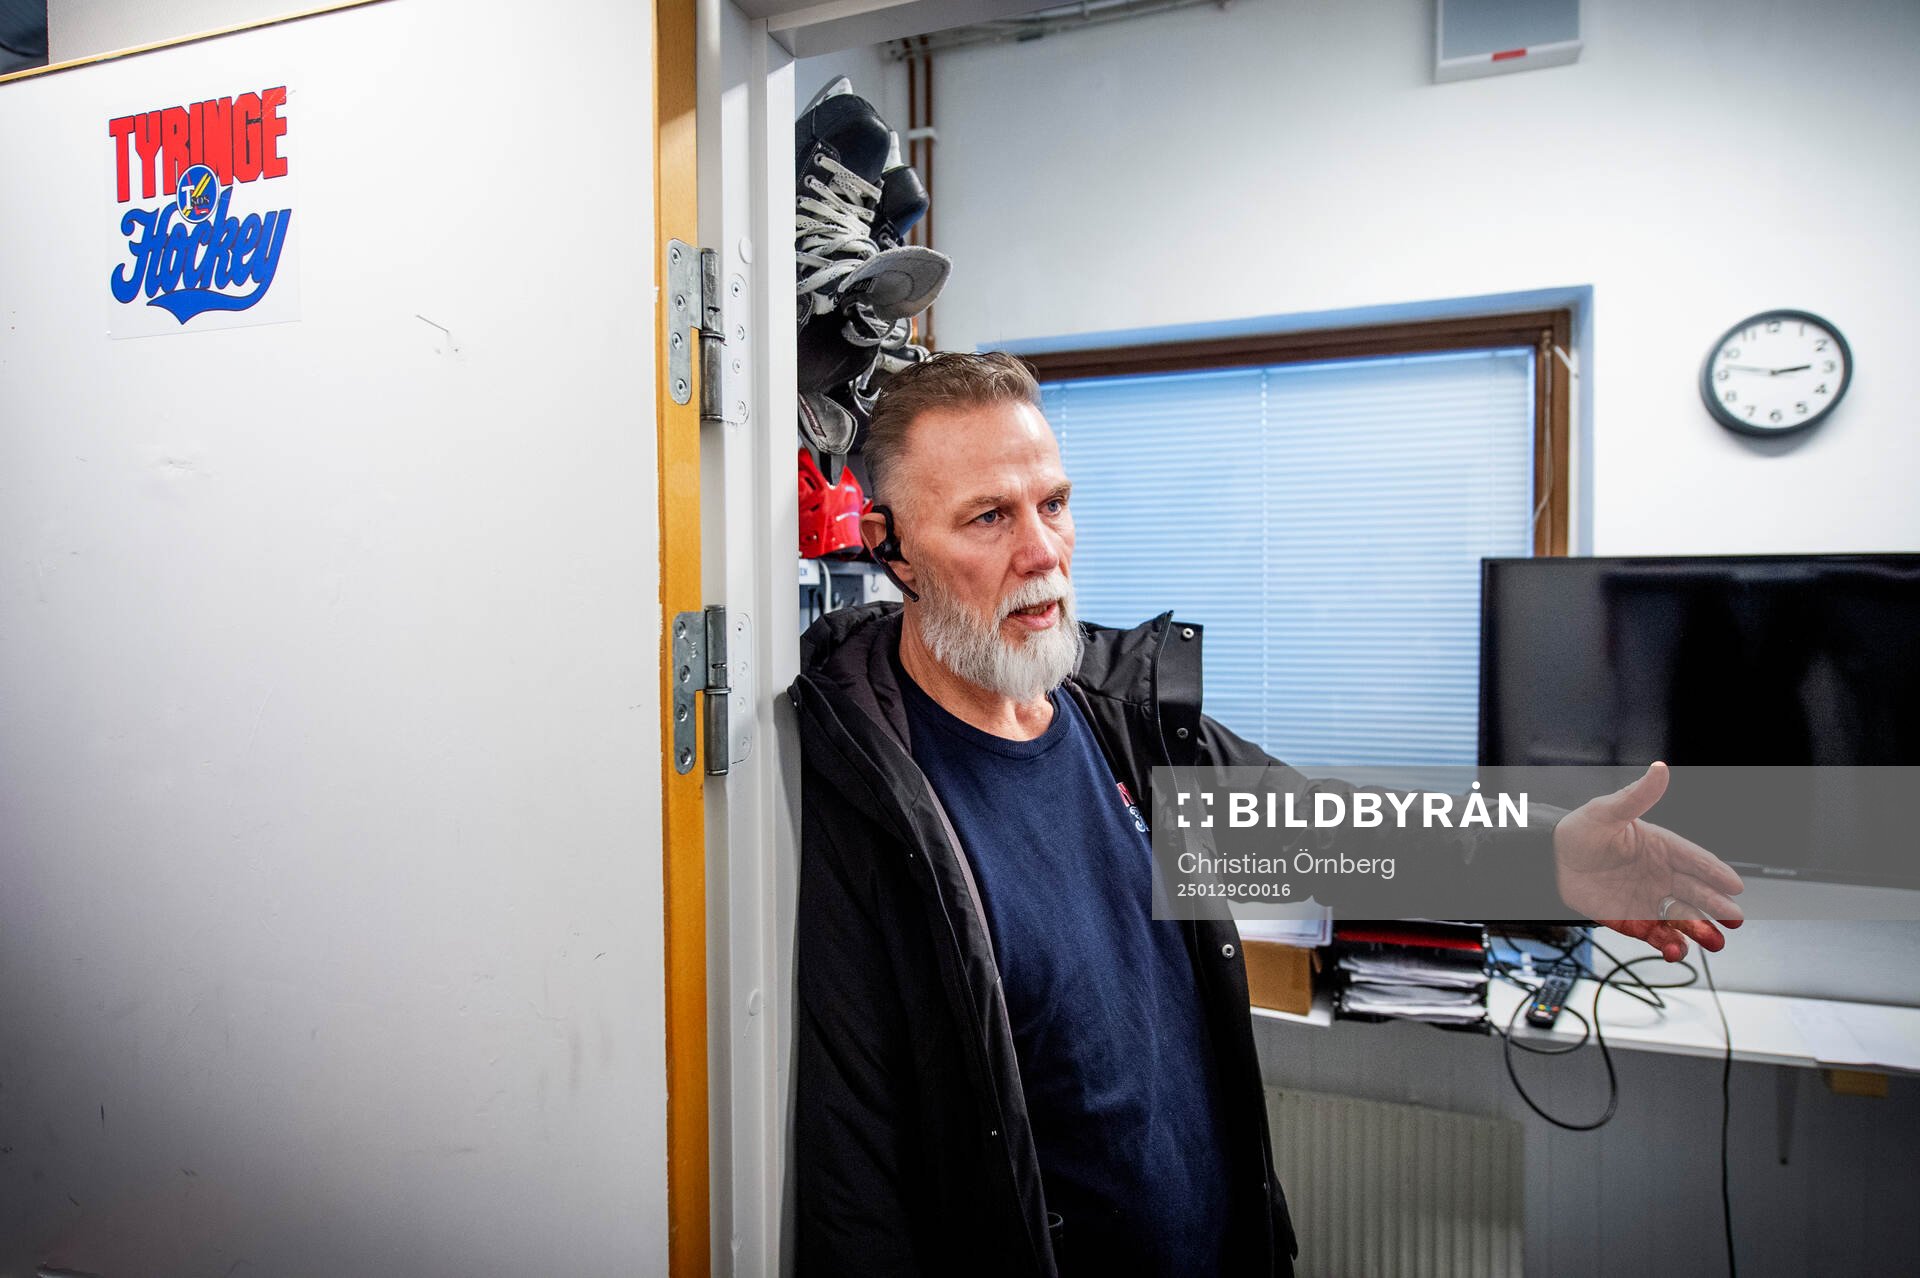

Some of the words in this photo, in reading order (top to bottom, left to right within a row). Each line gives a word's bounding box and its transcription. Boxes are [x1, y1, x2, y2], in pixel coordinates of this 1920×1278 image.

[109, 85, 289, 203] TYRINGE
[111, 187, 292, 325] Hockey
[1766, 320, 1782, 333] 12
[1742, 329, 1757, 341] 11
[1815, 339, 1828, 352] 2
[1823, 360, 1836, 373] 3
[1717, 370, 1730, 381] 9
[1814, 383, 1828, 394] 4
[1744, 405, 1756, 417] 7
[1794, 401, 1808, 414] 5
[1769, 410, 1783, 422] 6
